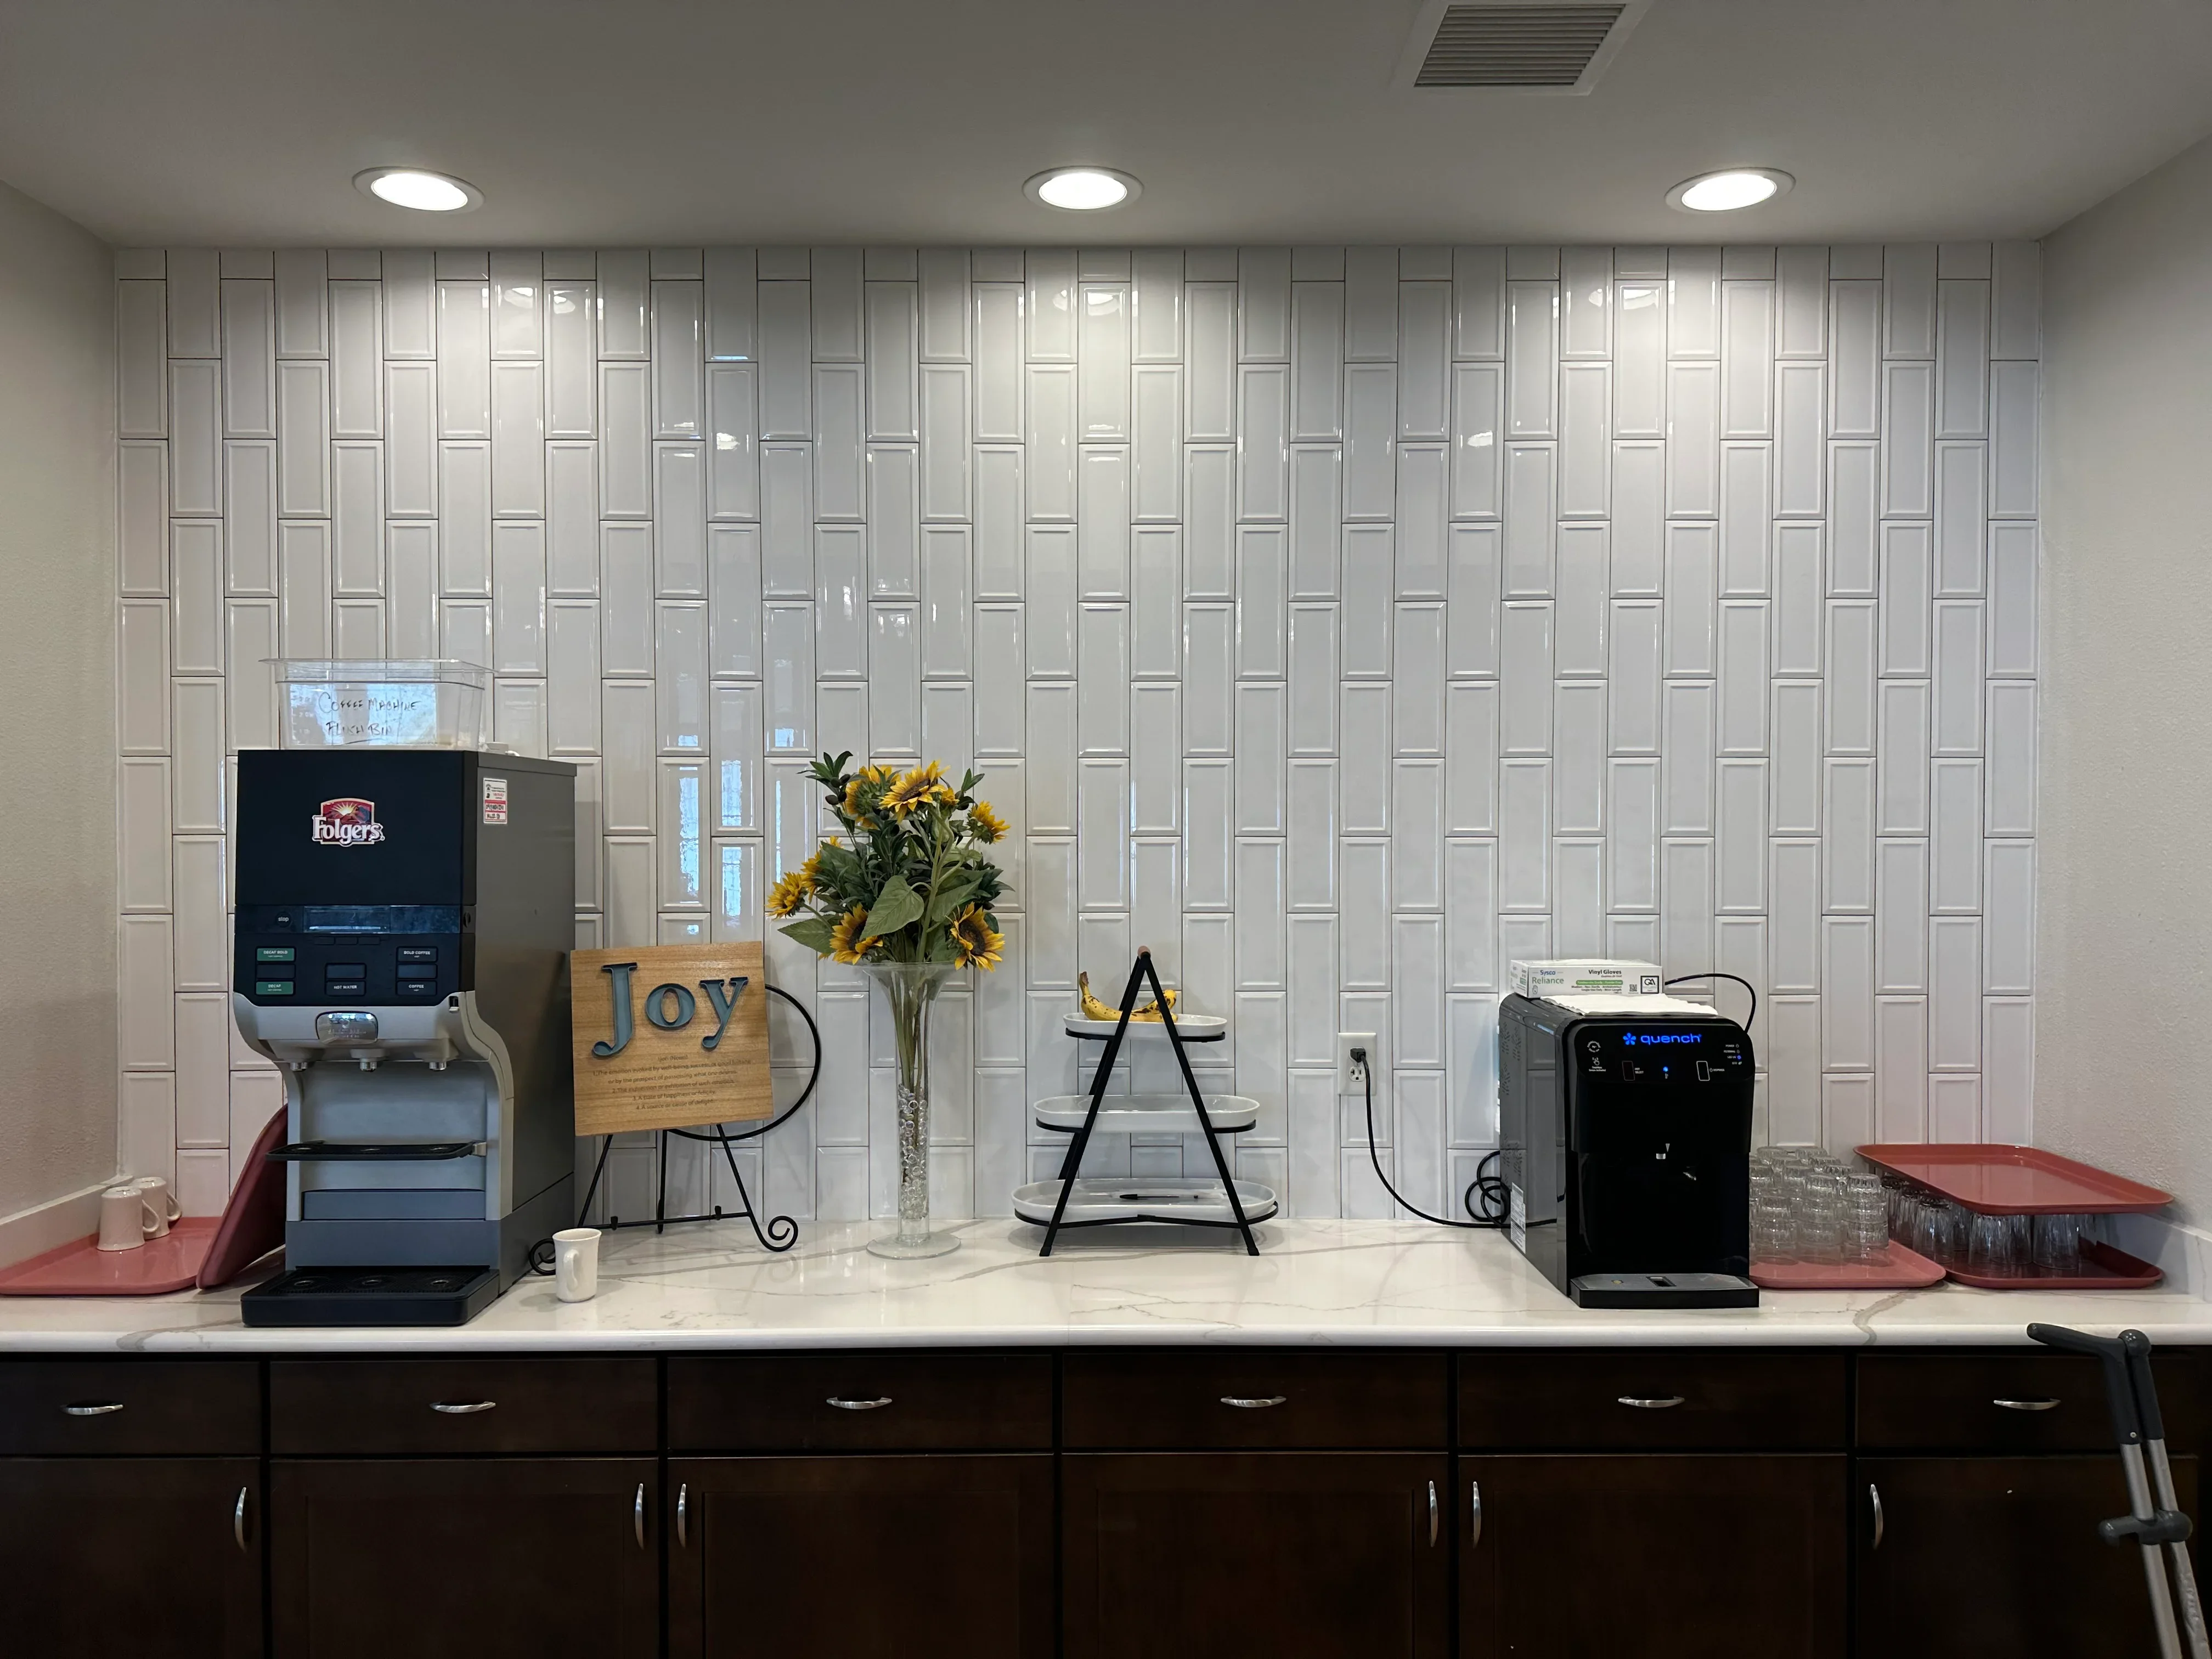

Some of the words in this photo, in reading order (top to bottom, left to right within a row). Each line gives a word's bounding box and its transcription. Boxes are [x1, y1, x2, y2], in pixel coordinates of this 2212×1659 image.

[368, 697, 422, 711] MACHINE
[313, 816, 381, 844] Folgers
[591, 962, 749, 1057] Joy
[1640, 1034, 1700, 1046] quench
